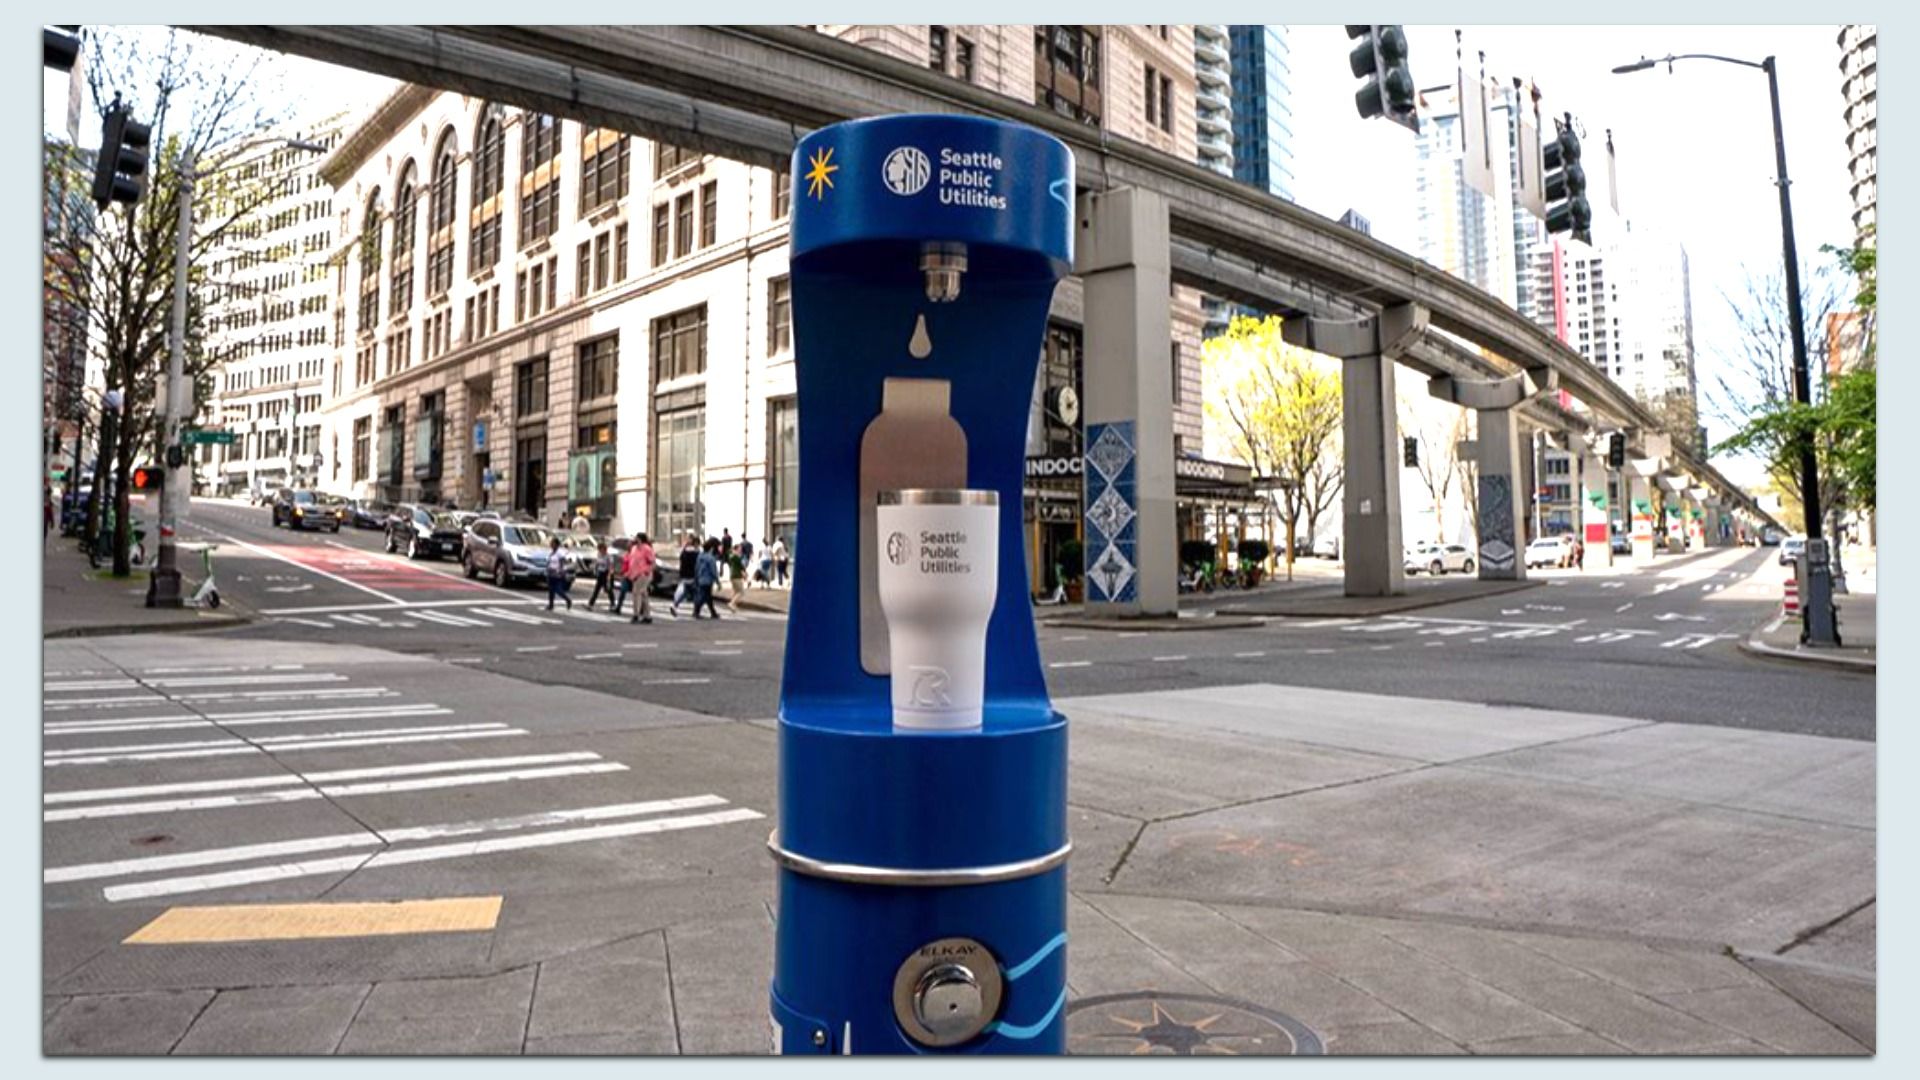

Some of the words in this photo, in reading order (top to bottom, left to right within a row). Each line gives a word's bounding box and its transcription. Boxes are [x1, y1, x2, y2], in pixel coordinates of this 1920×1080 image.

[940, 148, 1003, 170] Seattle
[940, 168, 992, 188] Public
[939, 187, 1007, 210] Utilities
[920, 531, 967, 544] Seattle
[920, 546, 959, 559] Public
[920, 561, 971, 574] Utilities
[920, 945, 976, 956] ELKAY
